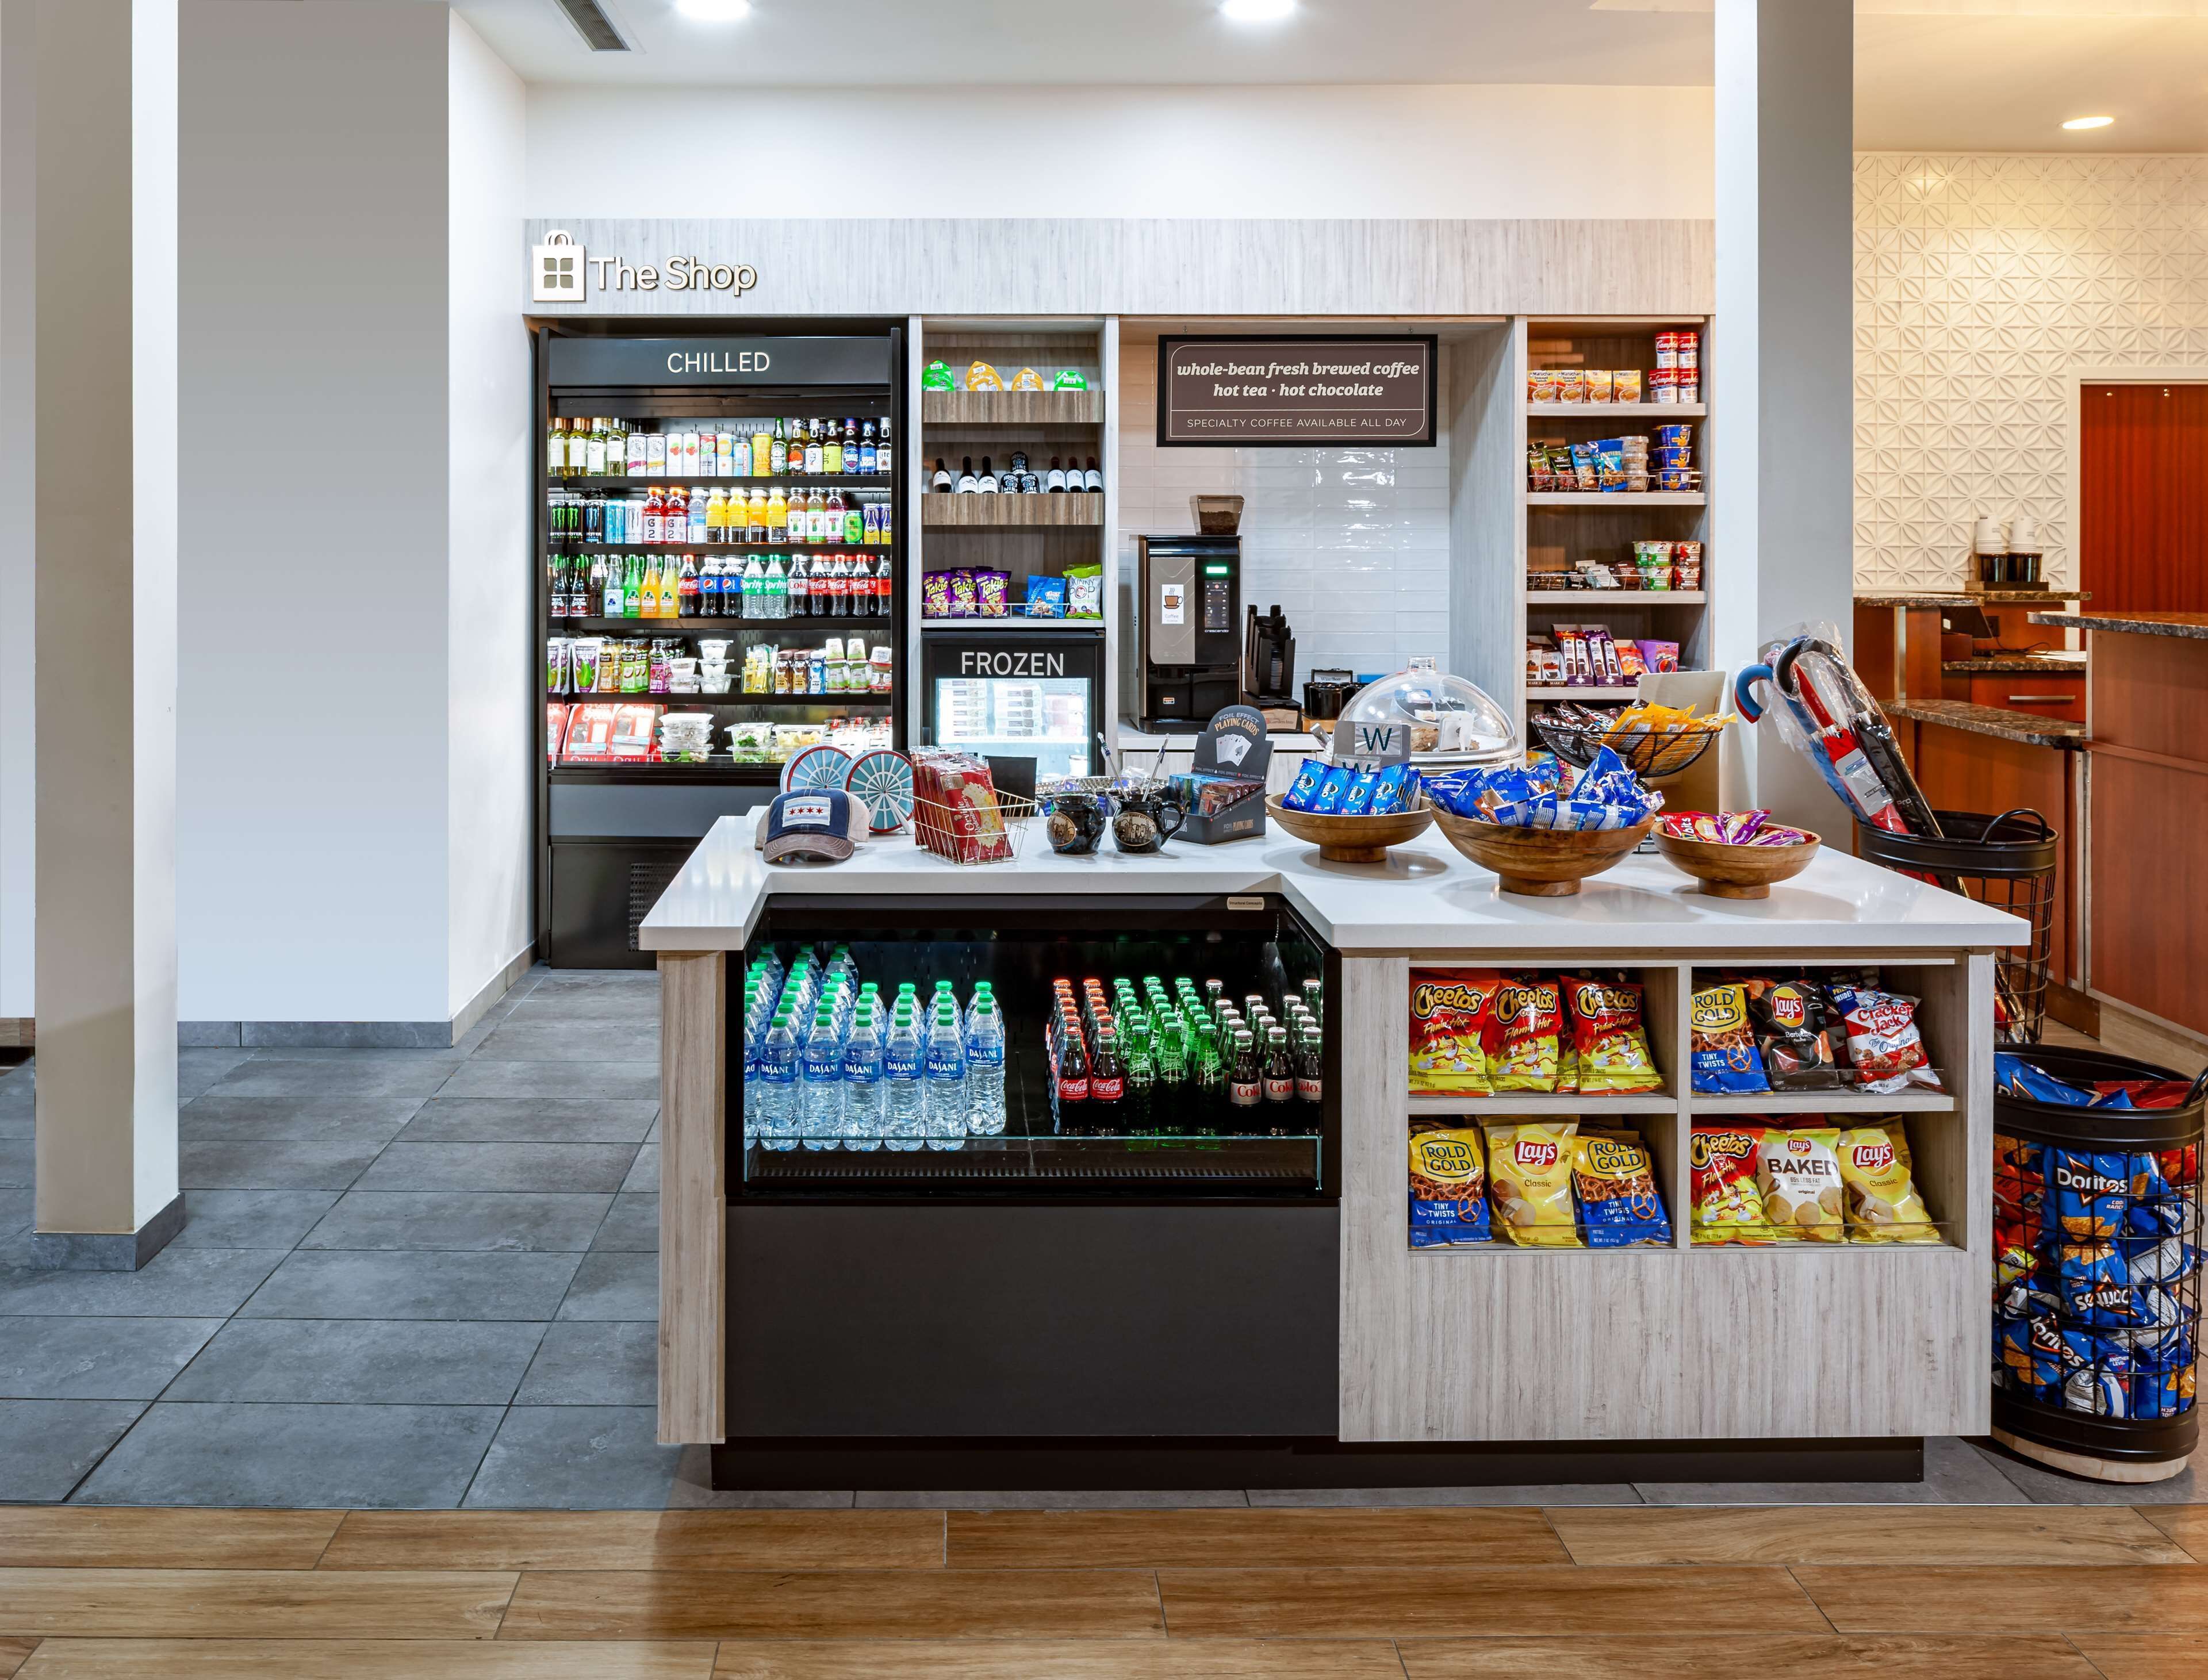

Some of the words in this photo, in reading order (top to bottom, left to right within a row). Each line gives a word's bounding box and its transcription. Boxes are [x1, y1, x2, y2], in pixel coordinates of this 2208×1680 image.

[589, 256, 658, 290] The
[664, 255, 758, 298] Shop
[667, 352, 770, 373] CHILLED
[1177, 363, 1265, 375] whole-bean
[1267, 362, 1309, 378] fresh
[1313, 362, 1370, 375] brewed
[1373, 362, 1419, 378] coffee
[1214, 384, 1239, 396] hot
[1243, 385, 1267, 396] tea
[1279, 384, 1305, 396] hot
[1309, 383, 1383, 396] chocolate
[1187, 419, 1247, 427] SPECIALTY
[1251, 419, 1293, 427] COFFEE
[1297, 419, 1356, 427] AVAILABLE
[1361, 419, 1381, 427] ALL
[1386, 419, 1407, 427] DAY
[648, 519, 655, 527] G
[668, 519, 674, 527] G
[649, 530, 655, 538] 2
[668, 530, 674, 538] 2
[742, 580, 763, 590] Sprite
[926, 581, 948, 597] Takis
[952, 581, 976, 596] Takis
[980, 579, 1004, 598] Takis
[961, 652, 1064, 677] FROZEN
[1219, 713, 1235, 721] FOIL
[1236, 712, 1259, 724] EFFECT
[1214, 718, 1241, 731] PLAYING
[1241, 719, 1260, 736] CARDS
[1363, 728, 1392, 751] W
[1297, 773, 1308, 789] OREO
[1321, 781, 1333, 797] OREO
[1348, 785, 1359, 801] OREO
[1375, 781, 1386, 799] OREO
[957, 801, 975, 831] Orville
[1682, 818, 1694, 834] bits
[1414, 984, 1482, 1018] Cheetos
[1578, 988, 1638, 1018] Cheetos
[1694, 992, 1734, 1007] ROLD
[1834, 990, 1852, 1003] INSIDE!
[1435, 1007, 1459, 1017] Crunchy
[1496, 988, 1555, 1023] Cheetos
[1774, 997, 1801, 1019] Lay's
[1694, 1008, 1735, 1022] GOLD
[1857, 1004, 1914, 1022] Cracker
[1450, 1018, 1470, 1027] Hot
[1535, 1018, 1553, 1030] Hot
[1615, 1017, 1635, 1027] Hot
[1870, 1015, 1905, 1035] Jack
[1869, 1038, 1880, 1048] The
[1879, 1033, 1912, 1053] Original
[969, 1049, 998, 1059] DASANI
[761, 1064, 789, 1075] DASANI
[810, 1064, 838, 1075] DASANI
[845, 1064, 872, 1075] DASANI
[887, 1061, 916, 1072] DASANI
[929, 1061, 957, 1072] DASANI
[1697, 1060, 1725, 1068] TWISTS
[1060, 1080, 1087, 1092] Coca-Cola
[1092, 1079, 1120, 1092] Coca-Cola
[1427, 1146, 1466, 1159] ROLD
[1691, 1135, 1751, 1168] Cheetos
[1789, 1140, 1810, 1152] Lay's
[1518, 1141, 1555, 1166] Lay's
[1856, 1145, 1893, 1168] Lay's
[1430, 1159, 1471, 1172] GOLD
[1597, 1154, 1642, 1169] GOLD
[1767, 1159, 1838, 1175] BAKED
[1524, 1179, 1552, 1188] Classic
[1869, 1178, 1898, 1187] Classic
[2057, 1167, 2128, 1194] Doritos
[1604, 1207, 1630, 1215] TWISTS
